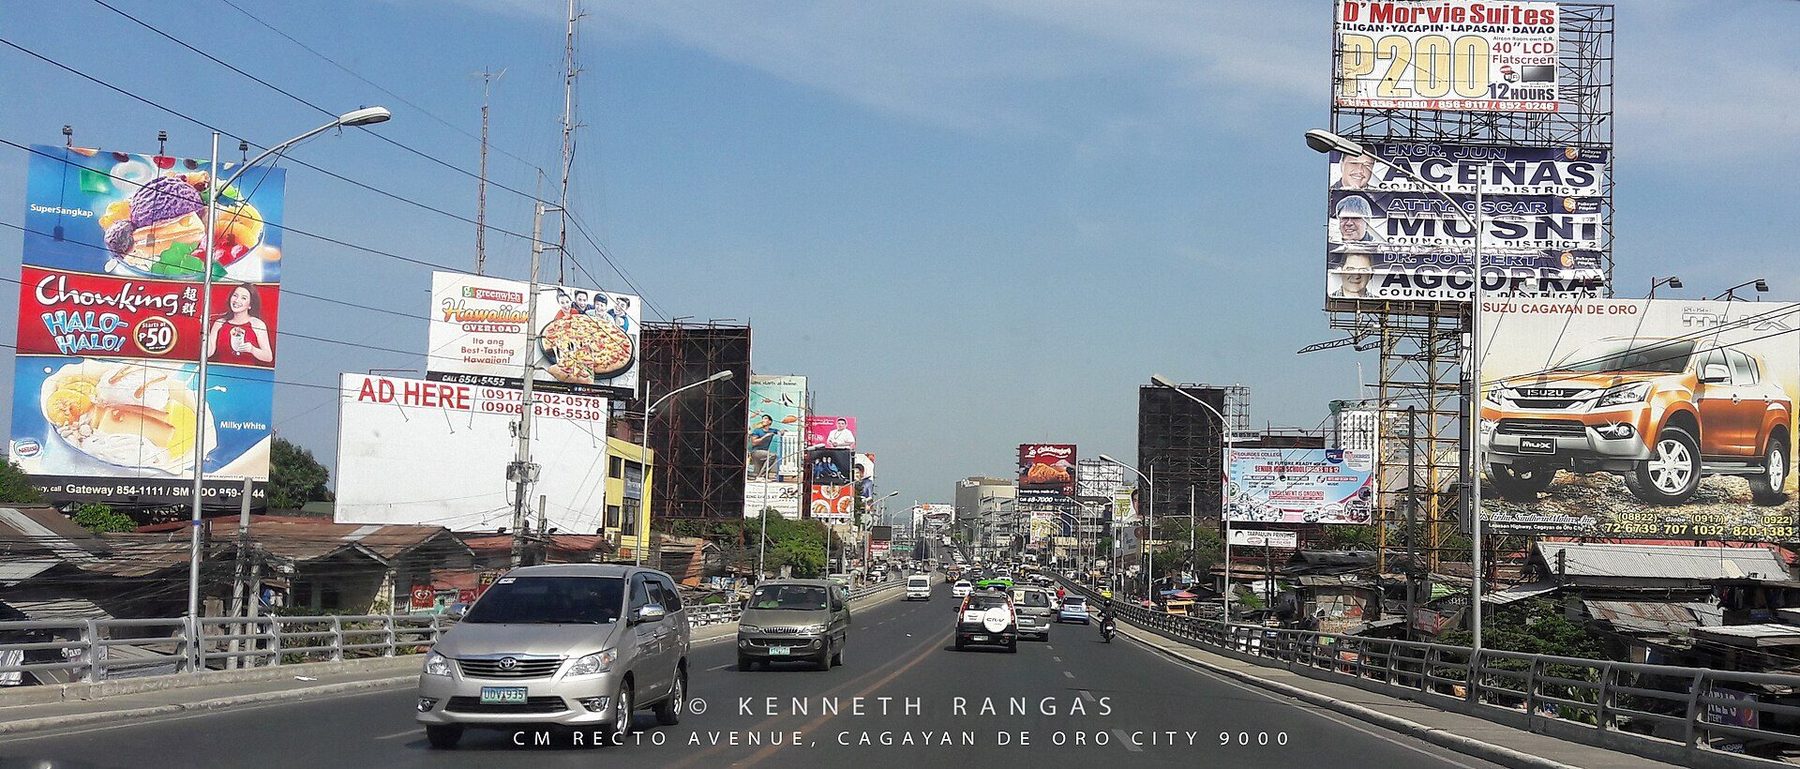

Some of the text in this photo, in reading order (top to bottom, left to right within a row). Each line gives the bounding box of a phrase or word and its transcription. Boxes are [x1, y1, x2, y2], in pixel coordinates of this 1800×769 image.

[1469, 3, 1555, 25] Suites
[1342, 23, 1555, 34] ILIGAN YACAPIN LAPASAN DAVAO
[1523, 42, 1554, 54] LCD
[1492, 54, 1554, 65] Flatscreen
[1453, 146, 1507, 160] JUN
[1383, 156, 1595, 187] ACENAS
[30, 203, 94, 218] SuperSangkap
[1387, 198, 1548, 214] ATTY. OSCAR
[1387, 211, 1596, 241] MUSNI
[1383, 251, 1417, 263] DR.
[35, 274, 179, 316] Chowking
[475, 288, 522, 303] greenwich
[1521, 303, 1583, 314] CAGAYAN
[1587, 304, 1604, 315] DE
[1608, 304, 1638, 315] ORO
[462, 323, 521, 334] OVERLOAD
[54, 332, 125, 355] HALO!
[460, 346, 515, 357] Best-Tasting
[357, 377, 395, 404] AD
[404, 381, 471, 410] HERE
[534, 392, 600, 409] 702-0578
[1527, 389, 1564, 397] ISUZU
[535, 405, 600, 421] 816-5530
[220, 420, 266, 431] Milky White
[66, 484, 114, 497] Gateway
[116, 485, 164, 496] 854-1111
[172, 485, 190, 497] SM
[191, 487, 217, 497] DO
[1618, 512, 1658, 522] (08822)
[1760, 515, 1793, 526] (0922)
[1663, 524, 1688, 535] 707
[1692, 524, 1725, 535] 1032
